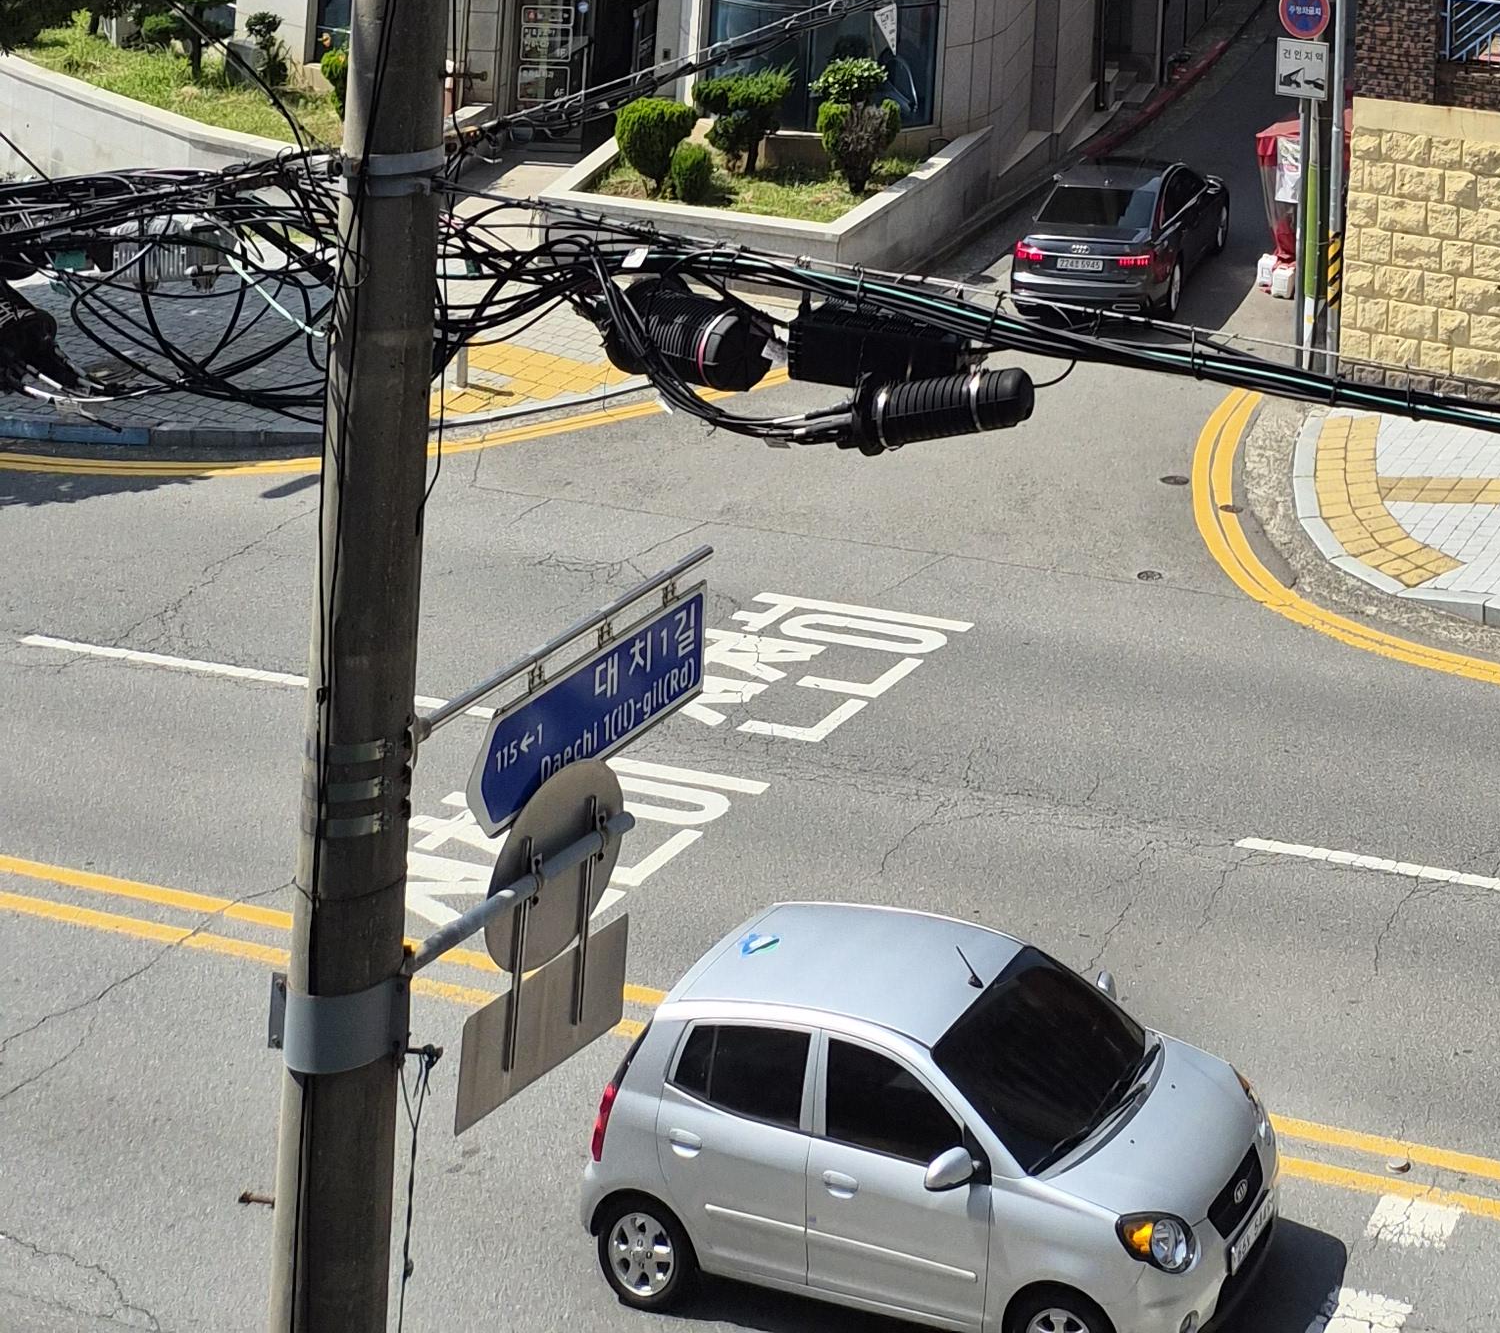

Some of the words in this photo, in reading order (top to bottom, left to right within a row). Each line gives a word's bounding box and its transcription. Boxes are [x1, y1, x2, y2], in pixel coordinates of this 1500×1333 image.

[496, 744, 518, 774] 115
[537, 723, 543, 745] 1
[540, 721, 598, 783] Daechi
